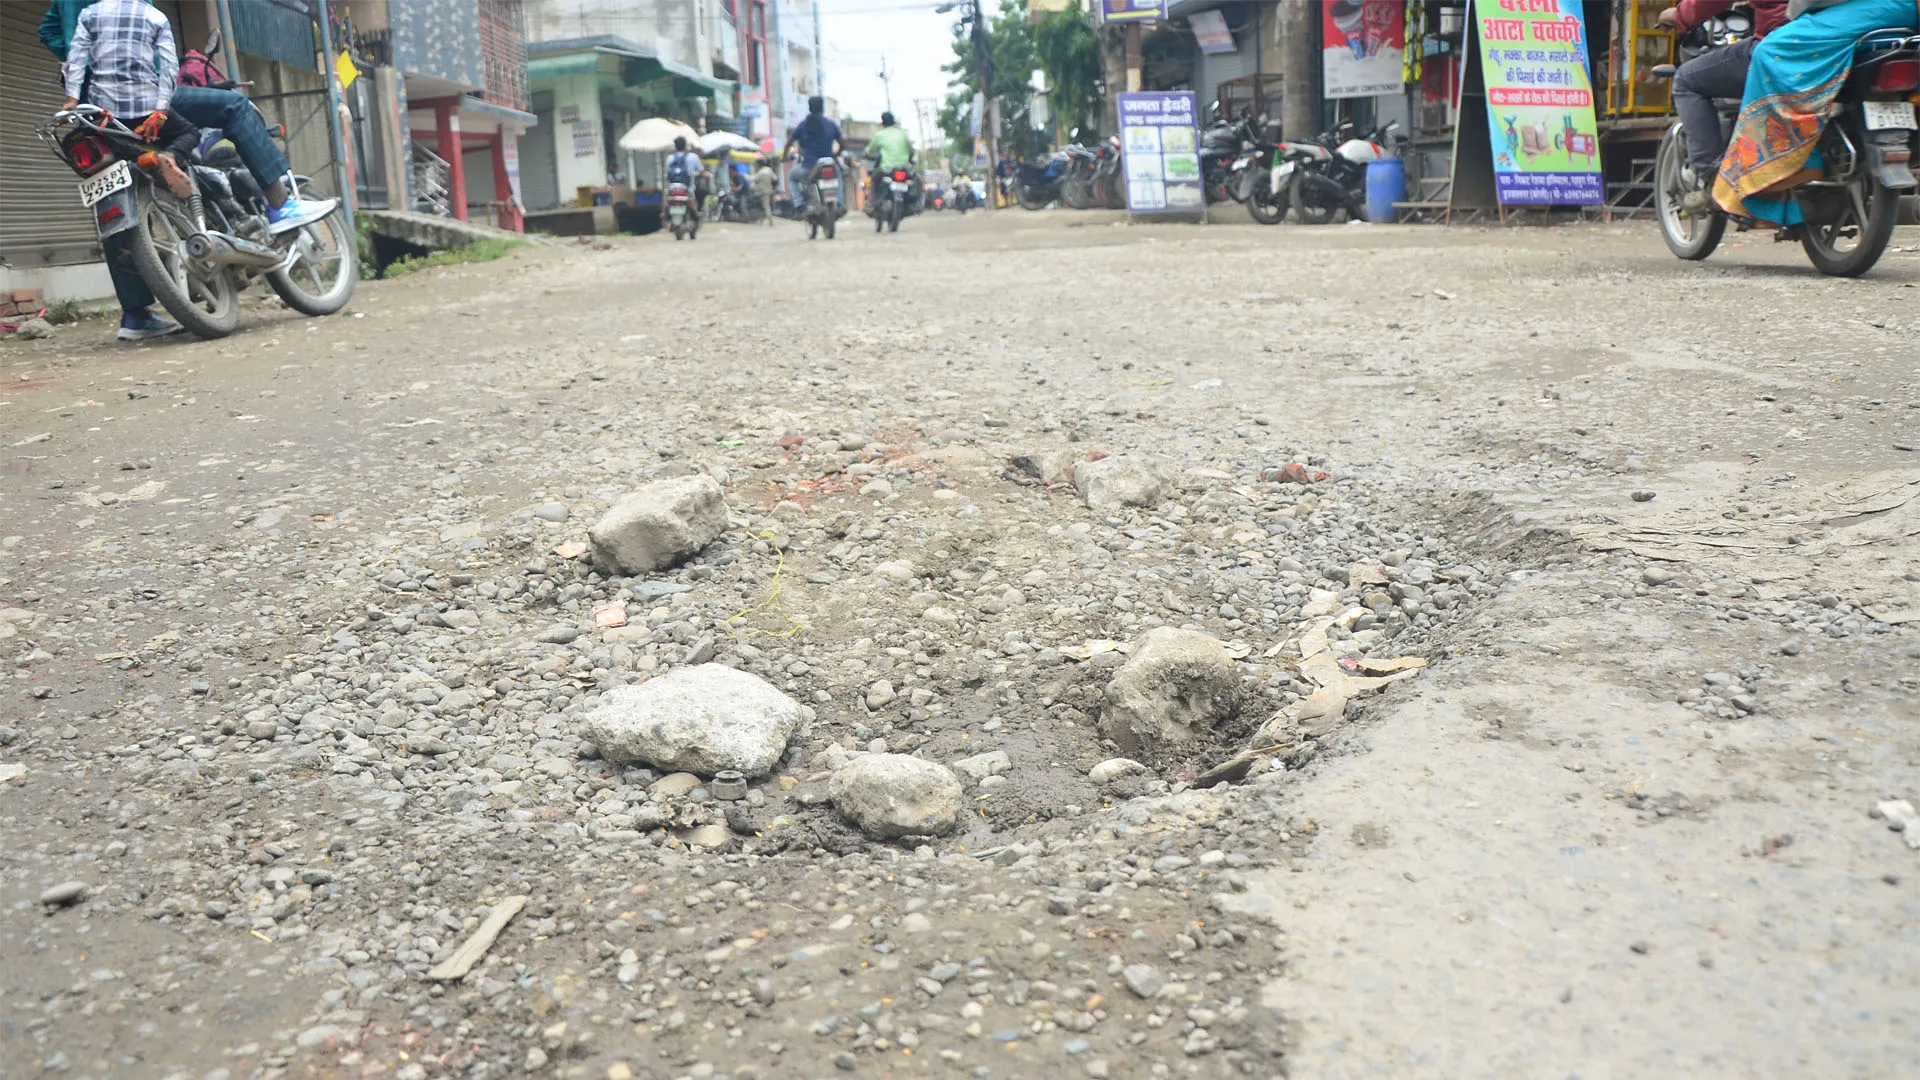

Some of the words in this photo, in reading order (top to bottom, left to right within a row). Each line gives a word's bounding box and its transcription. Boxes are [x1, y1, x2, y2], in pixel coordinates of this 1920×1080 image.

[1483, 18, 1525, 41] आटा
[1531, 16, 1581, 42] चक्की
[1506, 67, 1515, 82] की
[1537, 68, 1546, 82] की
